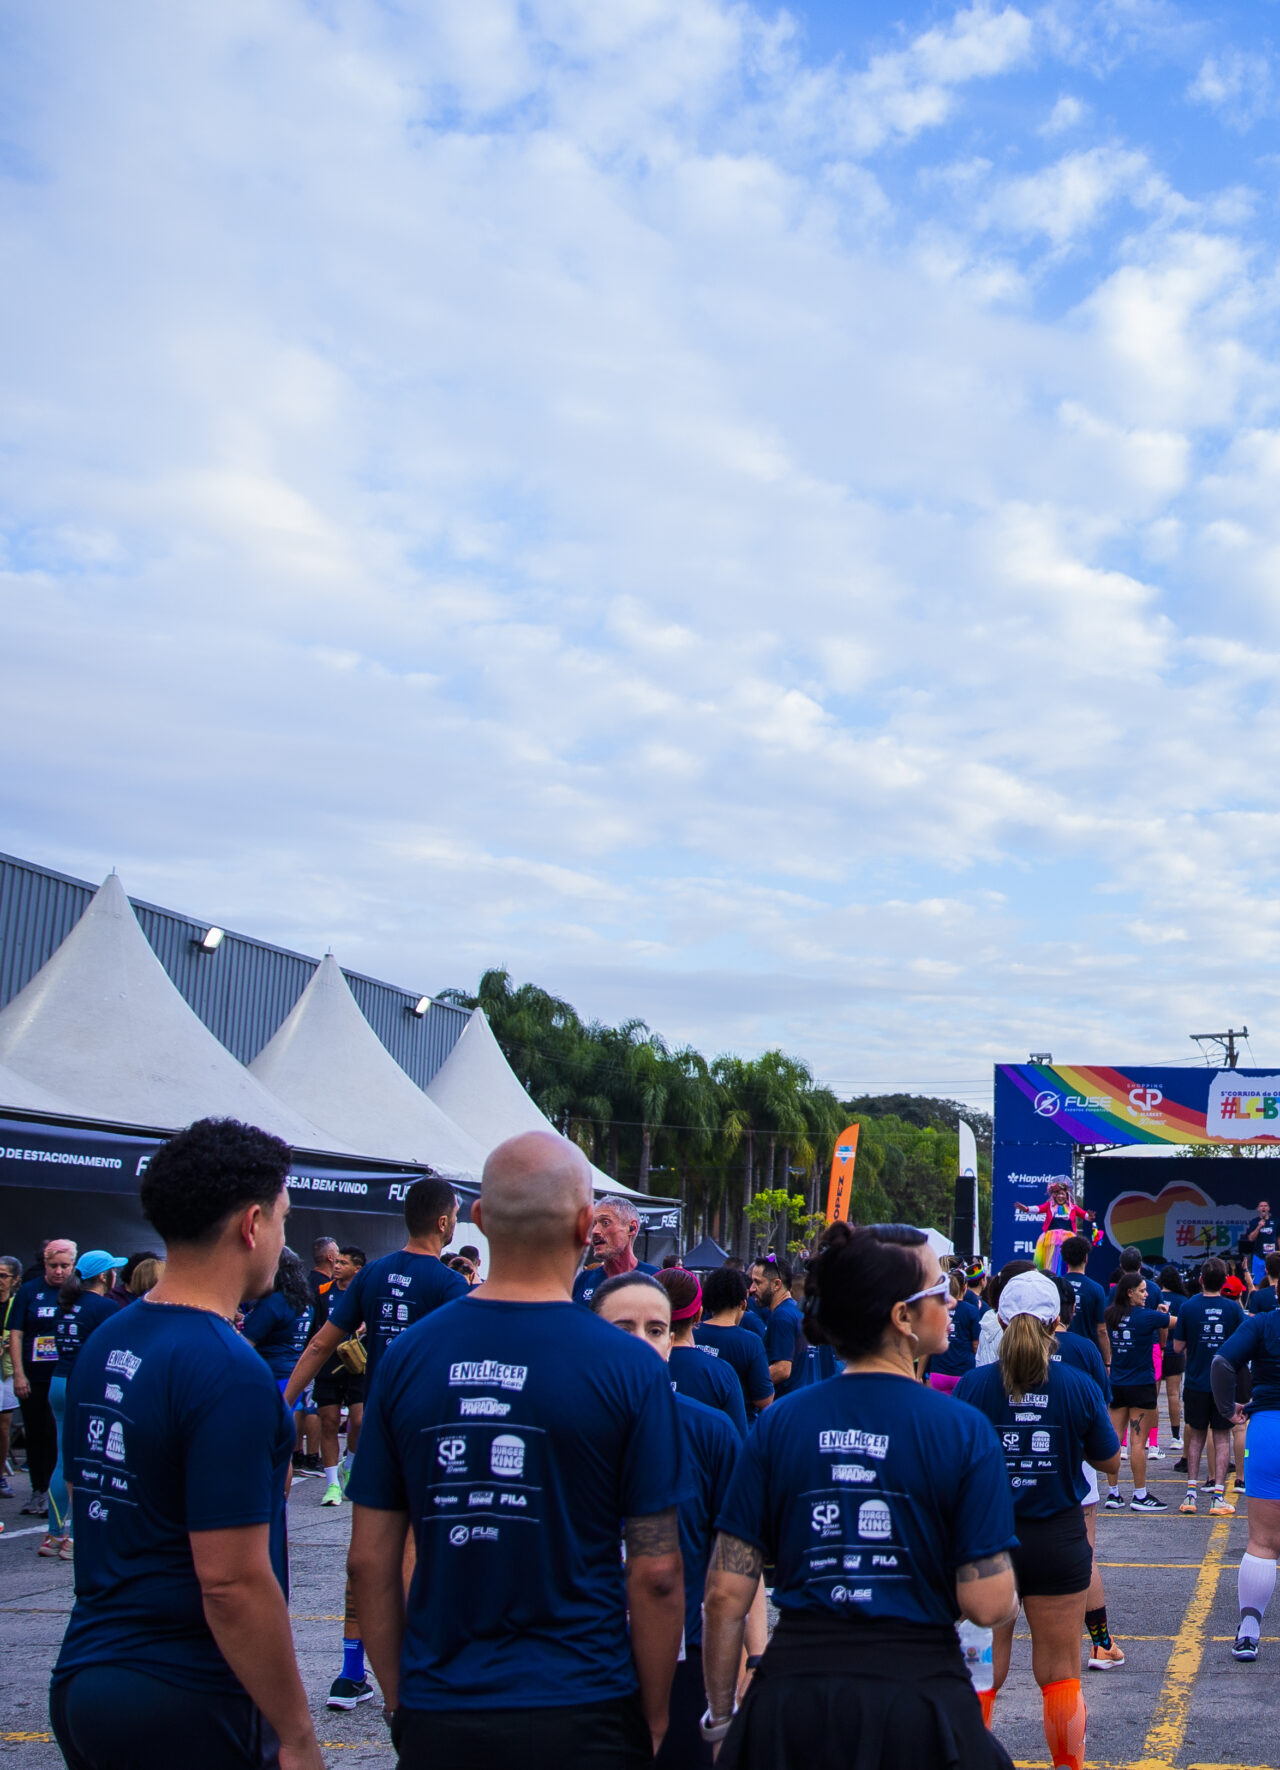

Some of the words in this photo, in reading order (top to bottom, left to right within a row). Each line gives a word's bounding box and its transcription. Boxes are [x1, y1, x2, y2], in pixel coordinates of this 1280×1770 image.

[1064, 1096, 1112, 1108] FUSE
[1127, 1088, 1163, 1117] SP
[6, 1147, 23, 1159] DE
[23, 1149, 122, 1169] ESTACIONAMENTO
[285, 1175, 310, 1189] SEJA
[311, 1178, 368, 1195] BEM-VINDO
[1019, 1174, 1053, 1184] Hapvid
[1014, 1241, 1036, 1253] FIL
[451, 1361, 527, 1380] ENVELHECER
[820, 1430, 889, 1450] ENVELHECER
[438, 1439, 466, 1466] SP
[491, 1445, 524, 1457] BURGER
[491, 1454, 524, 1468] KING
[112, 1476, 128, 1490] FILA
[500, 1493, 527, 1506] FILA
[812, 1504, 840, 1530] SP
[858, 1520, 892, 1531] KING
[872, 1555, 898, 1567] FILA
[848, 1588, 872, 1598] USE
